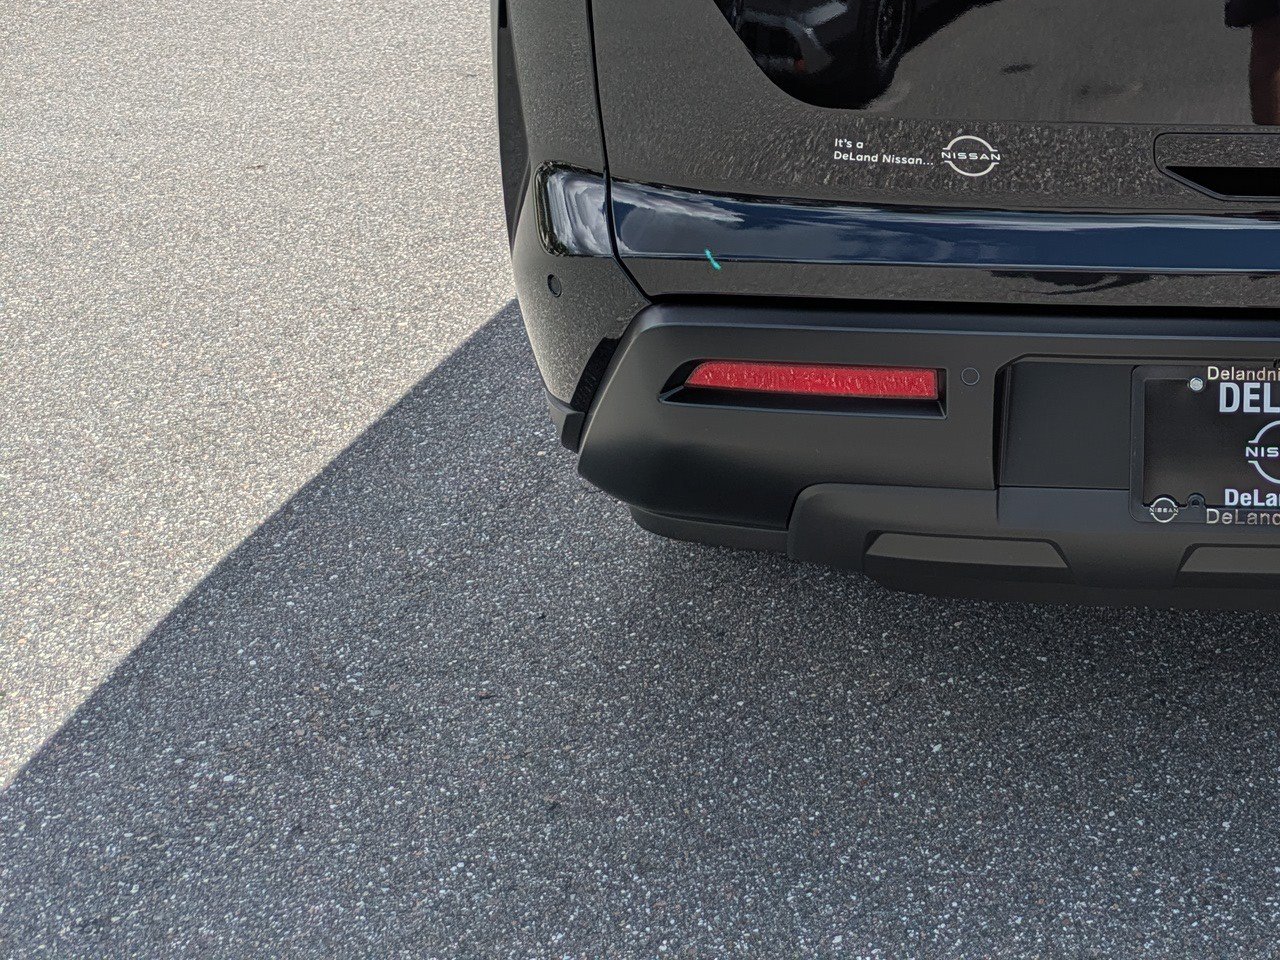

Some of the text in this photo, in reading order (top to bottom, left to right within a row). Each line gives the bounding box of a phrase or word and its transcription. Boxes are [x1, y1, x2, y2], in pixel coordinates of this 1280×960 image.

[834, 138, 864, 149] It's a
[833, 151, 934, 166] DeLand Nissan...
[941, 151, 1001, 161] NISSAN
